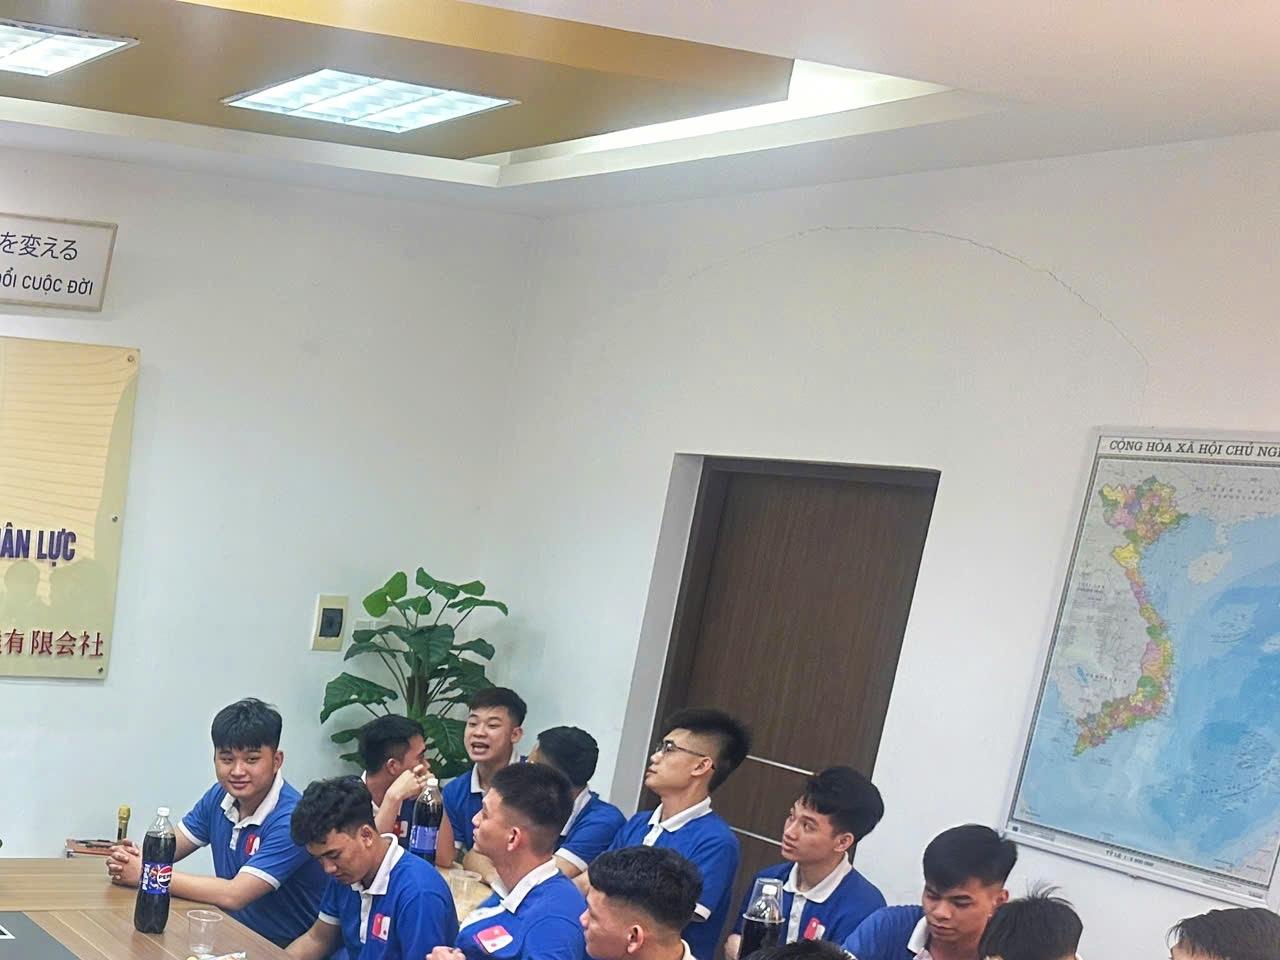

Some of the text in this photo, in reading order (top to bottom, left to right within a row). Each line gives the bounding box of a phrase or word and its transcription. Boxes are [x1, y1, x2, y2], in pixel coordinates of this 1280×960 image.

[22, 274, 63, 295] CUỘC
[67, 279, 94, 296] ĐỜI
[1109, 438, 1143, 452] CỘNG
[1146, 439, 1172, 453] HÒA
[1176, 441, 1196, 454] XÃ
[1198, 441, 1222, 457] HỘI
[1225, 441, 1254, 456] CHỦ
[36, 528, 77, 567] LỰC
